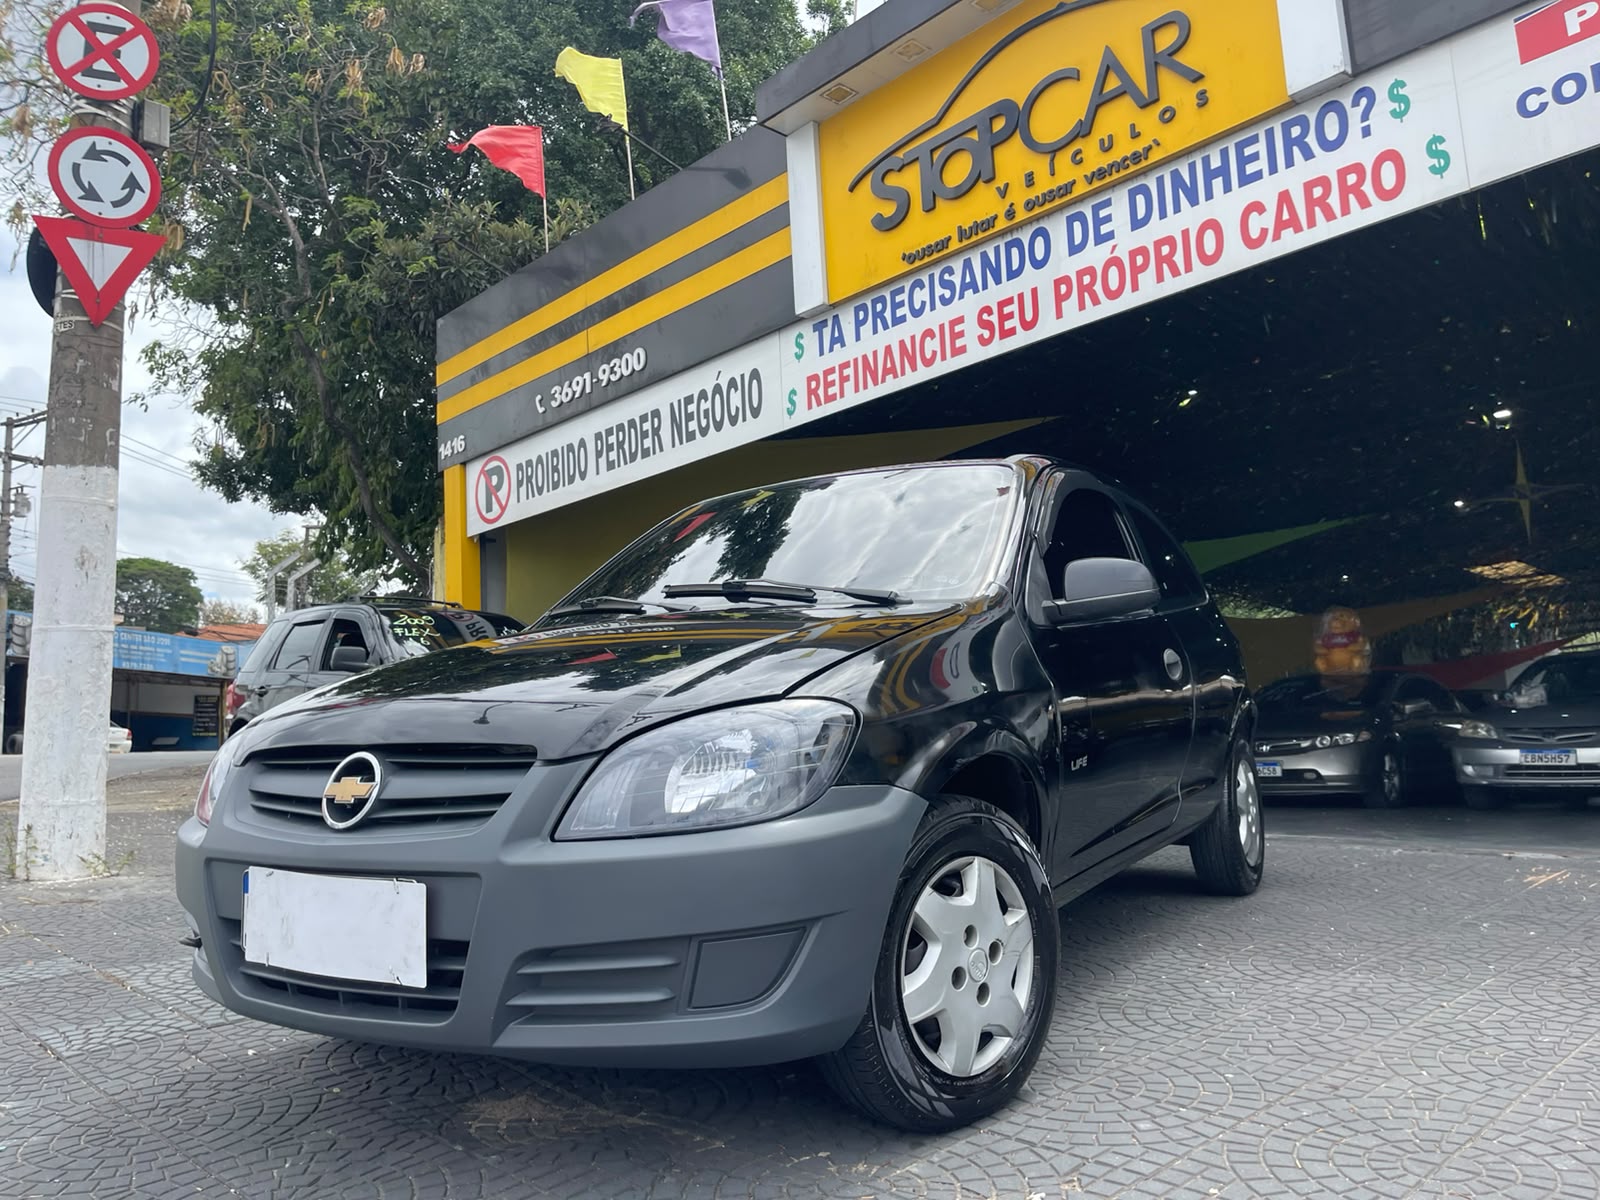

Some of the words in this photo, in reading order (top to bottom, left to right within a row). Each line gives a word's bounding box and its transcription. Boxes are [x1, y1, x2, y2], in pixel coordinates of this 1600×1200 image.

[1516, 62, 1600, 119] CO
[812, 313, 846, 357] TA
[853, 226, 1052, 342] PRECISANDO
[1065, 197, 1115, 257] DE
[1127, 86, 1377, 232] DINHEIRO?
[1387, 78, 1411, 122] $
[957, 213, 998, 243] lutar
[1003, 203, 1016, 221] é
[1023, 180, 1077, 212] ousar
[806, 315, 967, 411] REFINANCIE
[976, 286, 1039, 347] SEU
[1053, 217, 1225, 320] PRÓPRIO
[1239, 148, 1407, 250] CARRO
[1425, 134, 1451, 179] $
[550, 347, 647, 408] 3691-9300
[439, 434, 466, 460] 1416
[515, 437, 588, 503] PROIBIDO
[594, 408, 664, 475] PERDER
[669, 368, 763, 449] NEGÓCIO
[393, 627, 441, 637] FLEX
